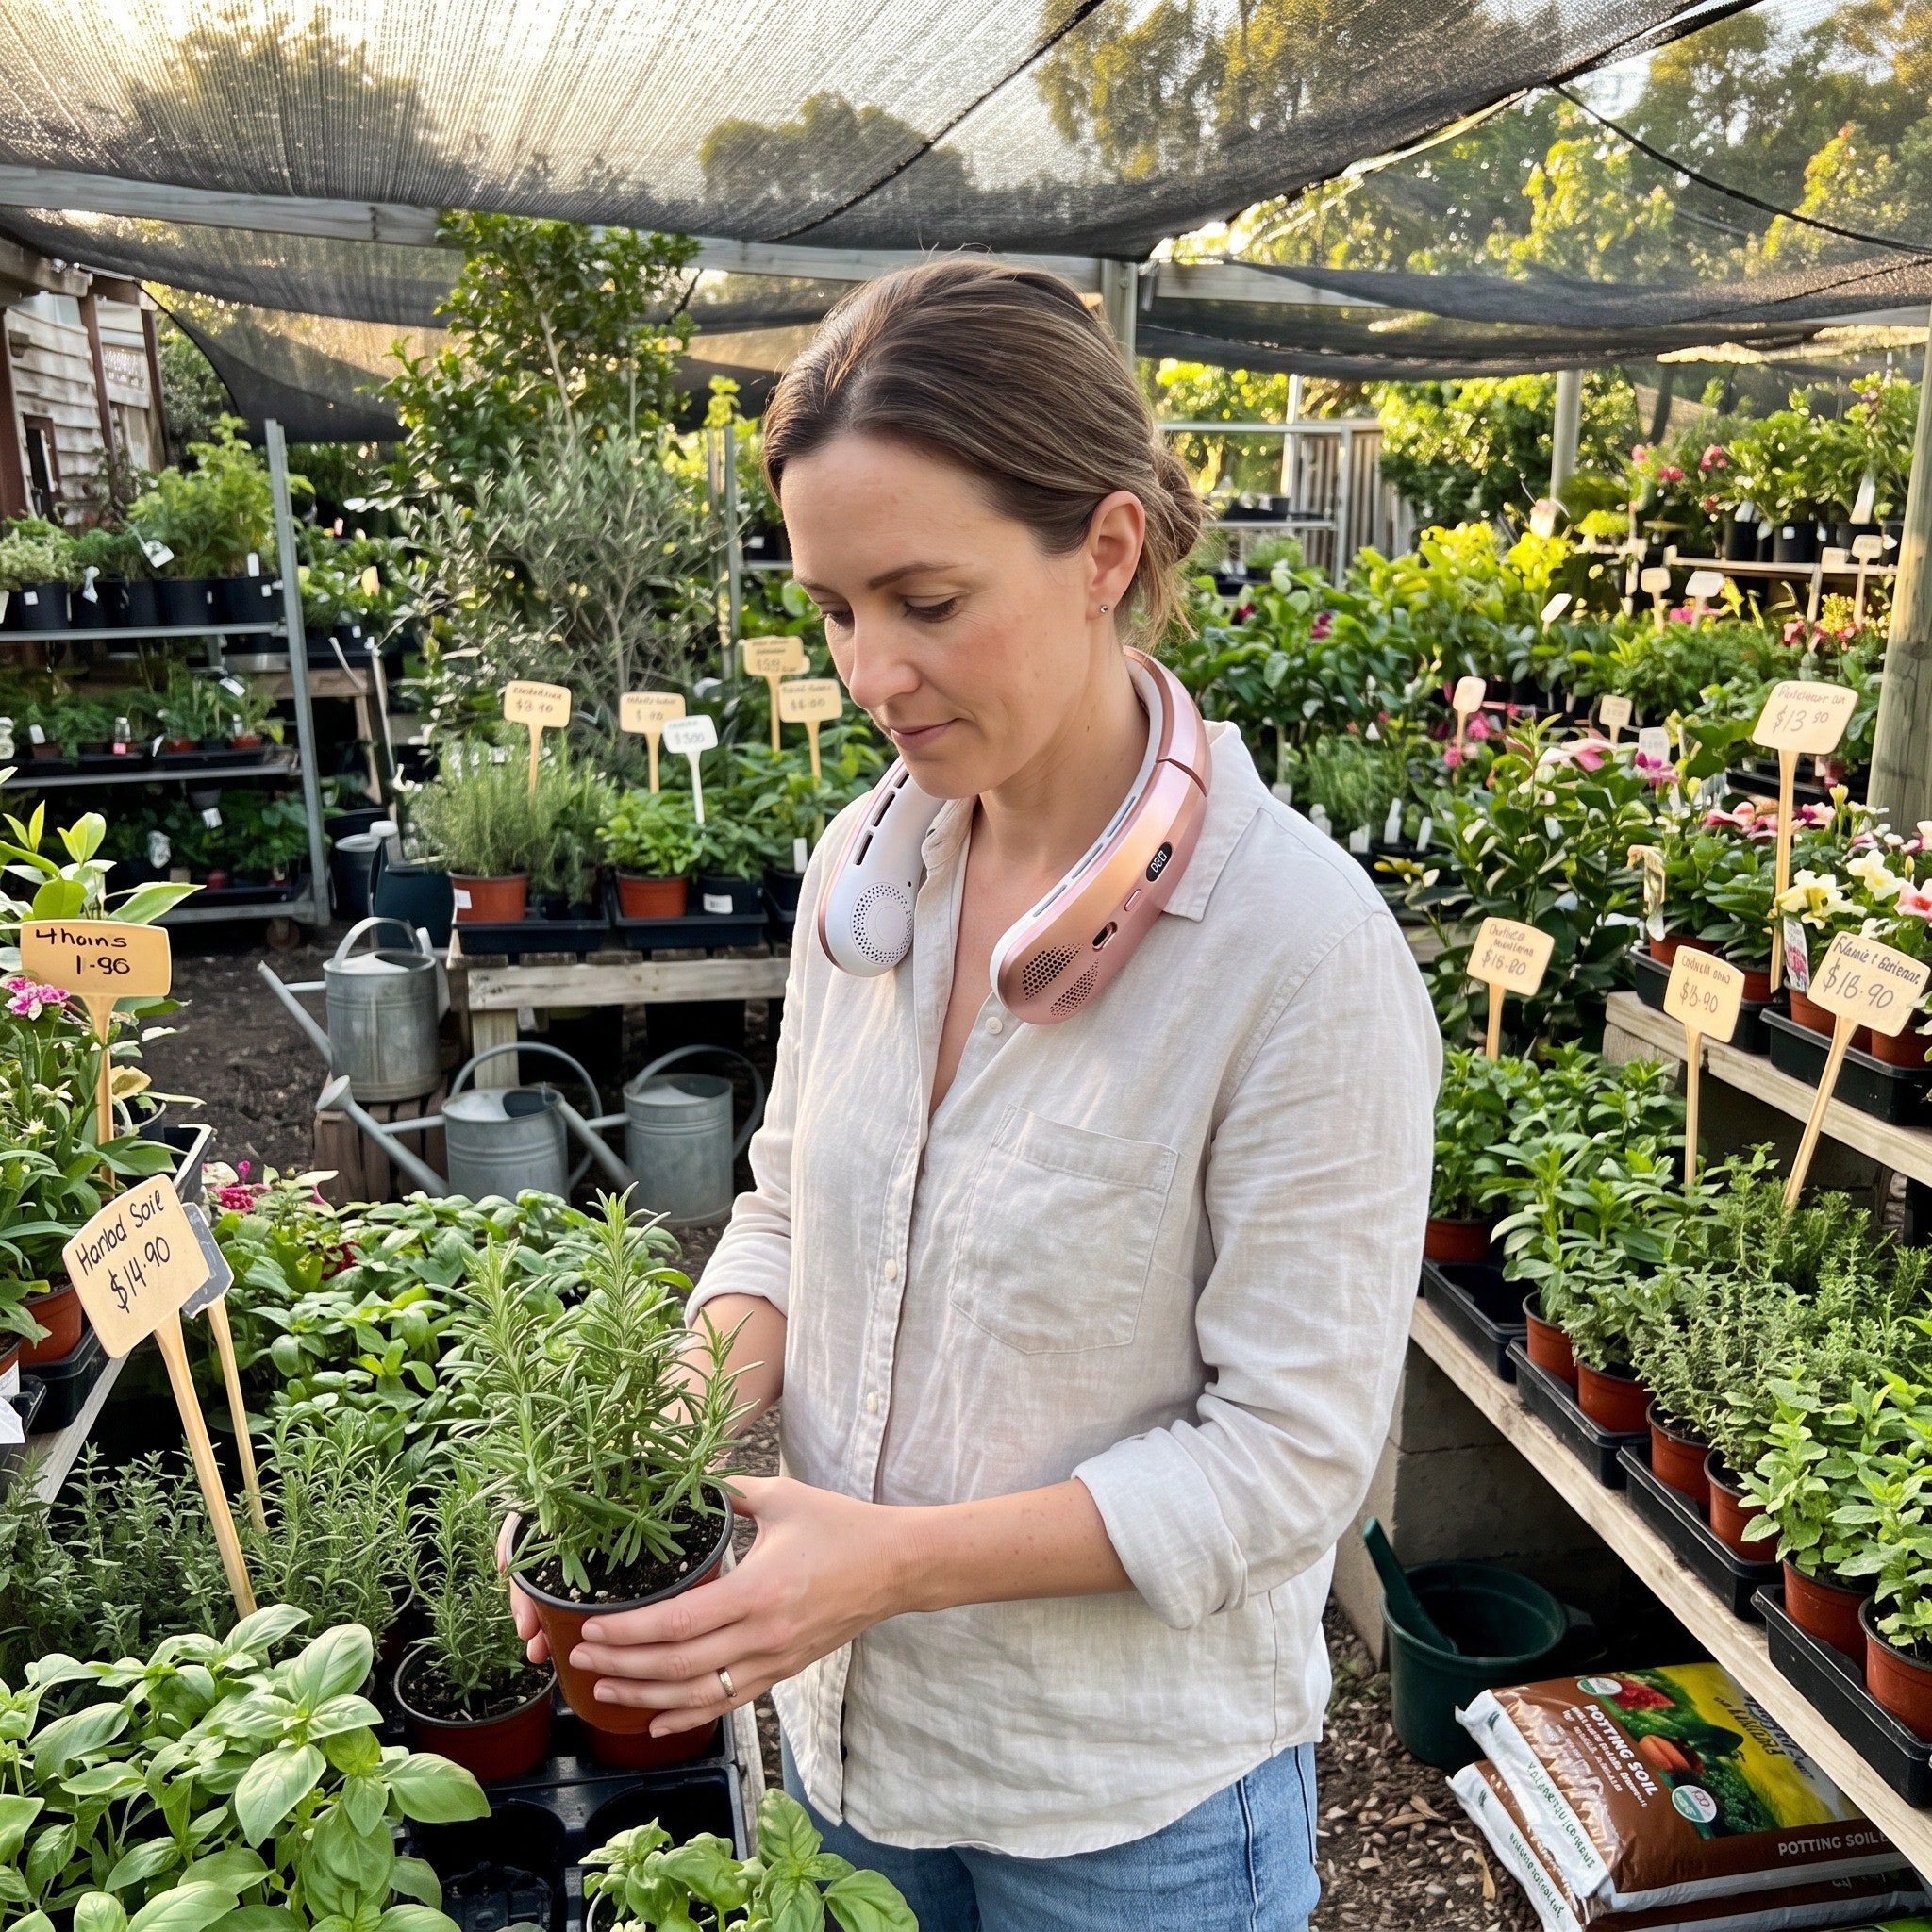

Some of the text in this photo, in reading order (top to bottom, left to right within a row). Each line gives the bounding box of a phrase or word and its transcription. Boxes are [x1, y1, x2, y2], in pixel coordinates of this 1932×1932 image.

[129, 1190, 164, 1228] Soil
[108, 1236, 171, 1314] $14.90
[1584, 1704, 1635, 1759] POTTING
[1627, 1761, 1659, 1797] SOIL
[1777, 1835, 1842, 1857] POTTING
[1845, 1831, 1879, 1848] SOIL
